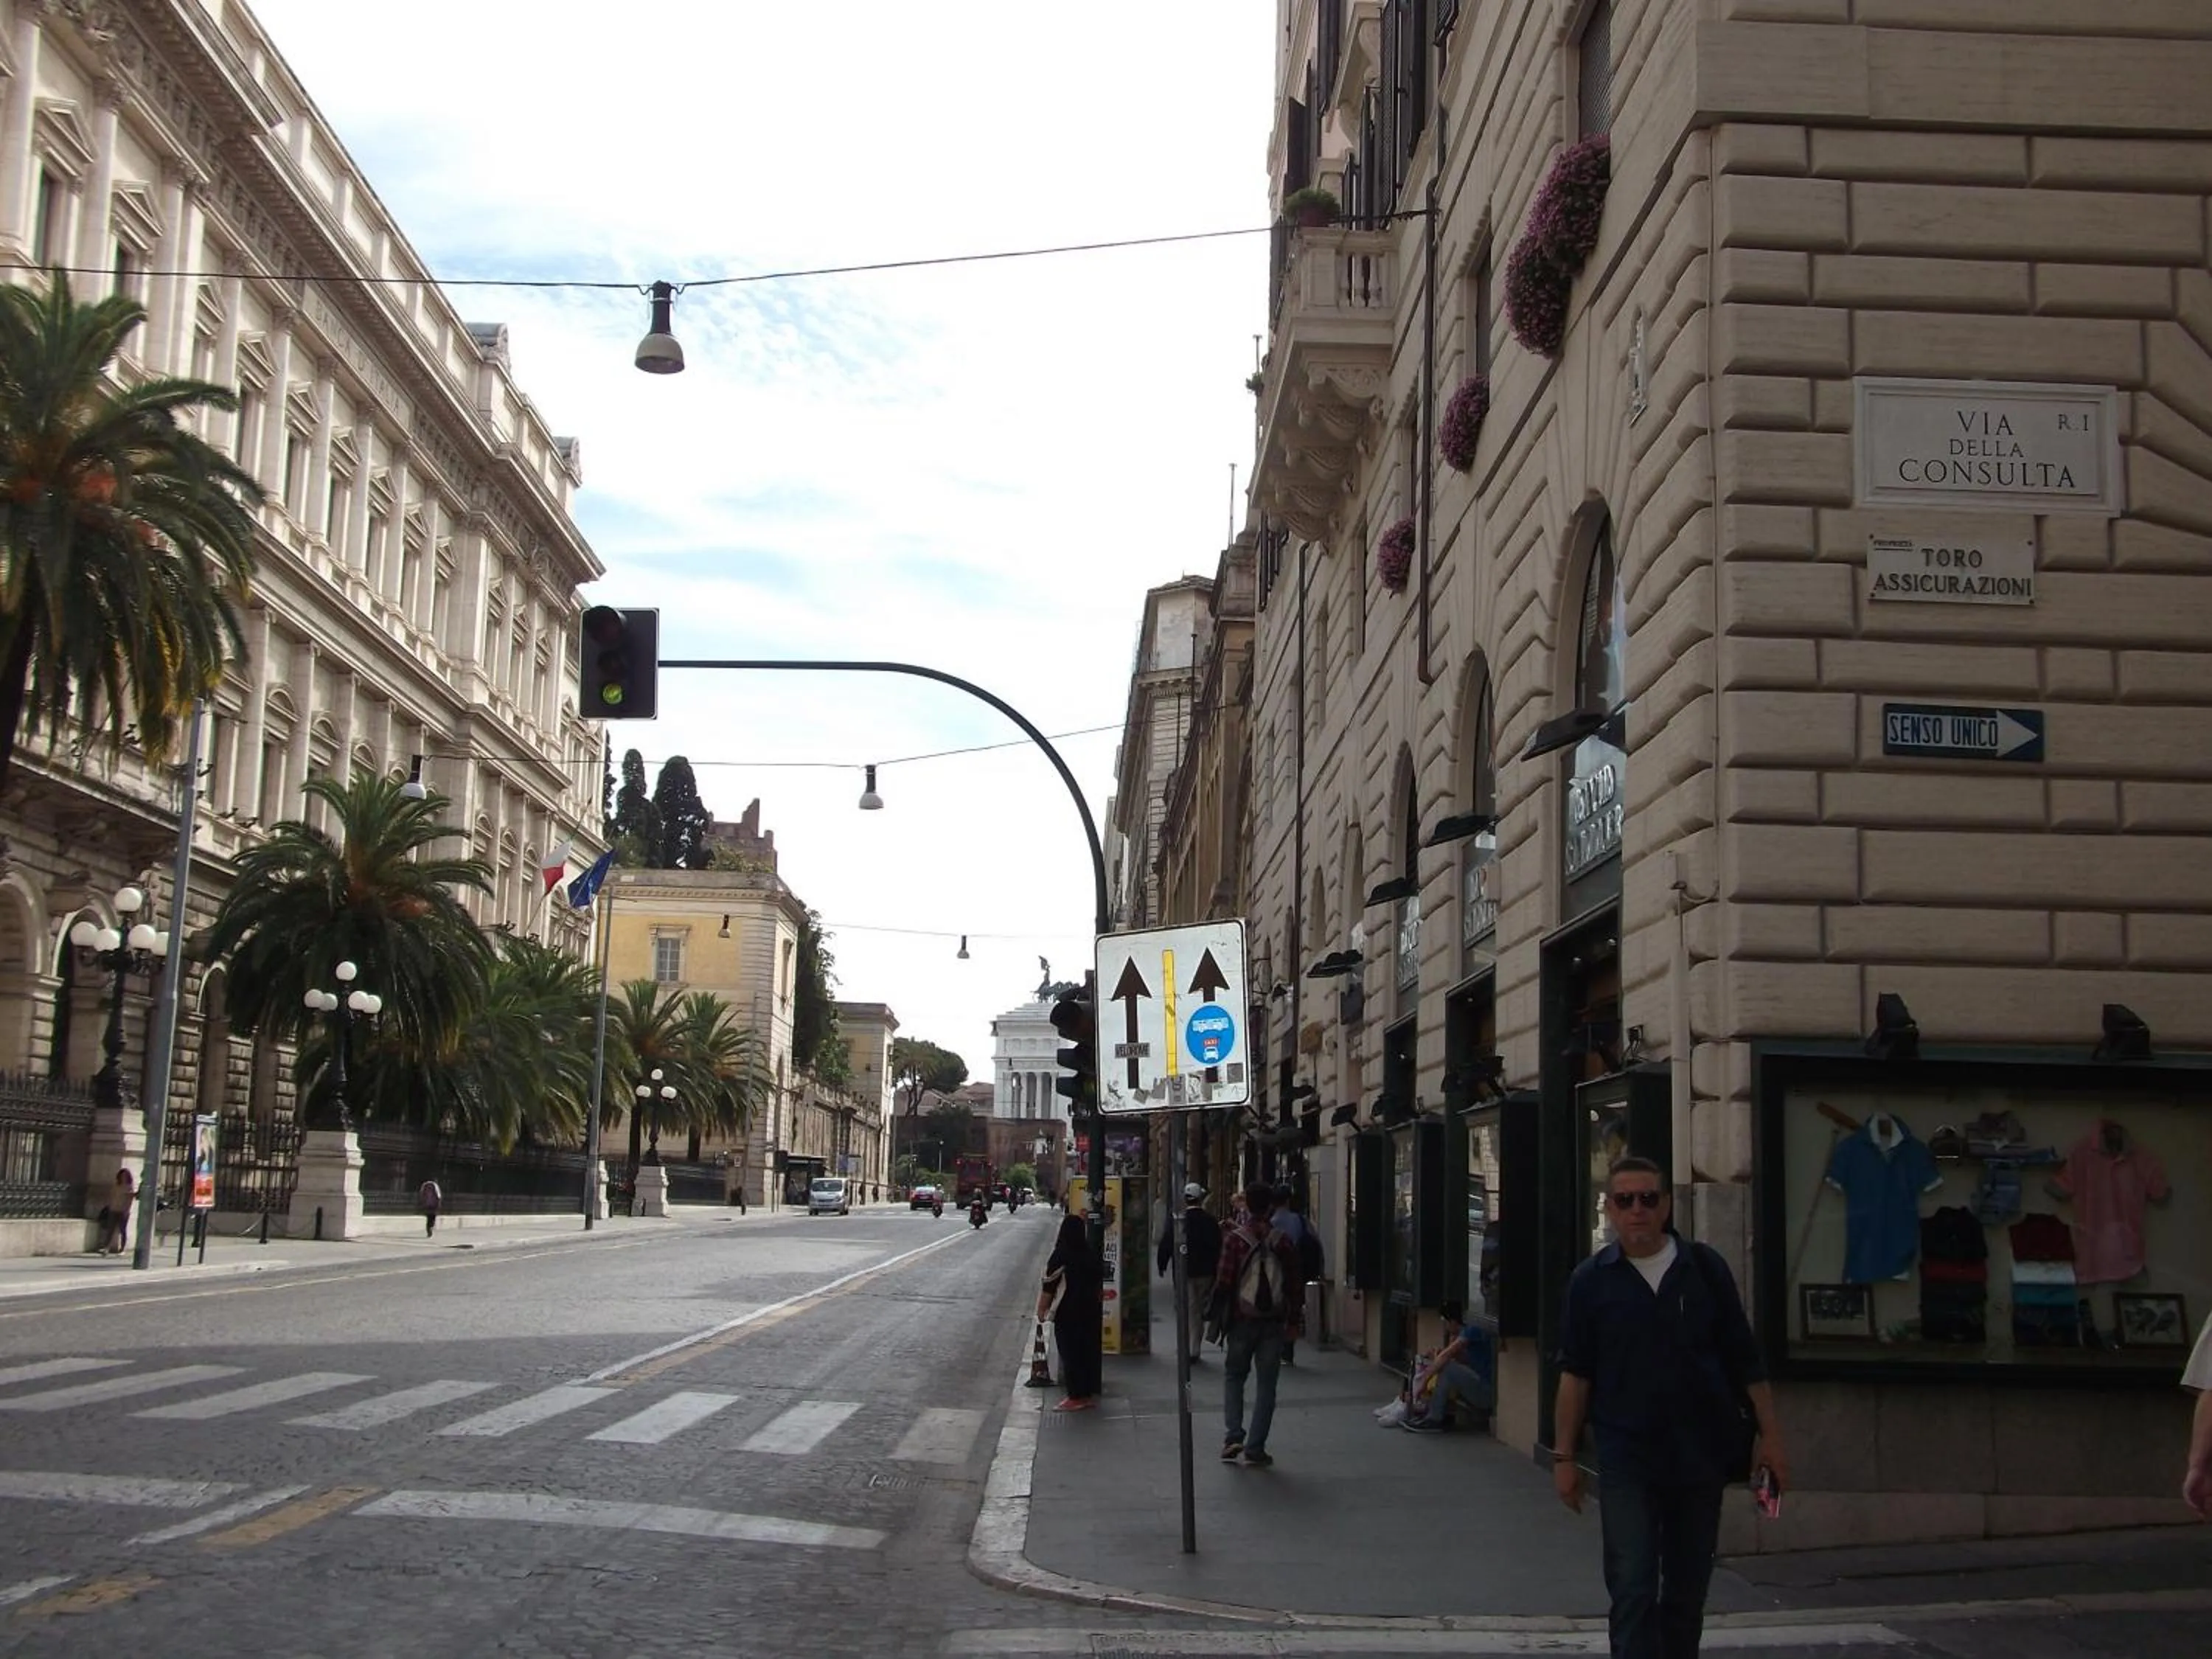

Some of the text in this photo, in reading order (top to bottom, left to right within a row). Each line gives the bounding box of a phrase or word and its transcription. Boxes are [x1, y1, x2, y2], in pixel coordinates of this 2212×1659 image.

[1957, 411, 2014, 436] VIA
[1950, 439, 2024, 458] DELLA
[1899, 458, 2076, 488] CONSULTA
[1921, 548, 1983, 568] TORO
[1873, 573, 2032, 597] ASSICURAZIONI
[1888, 715, 1998, 747] SENSO UNICO
